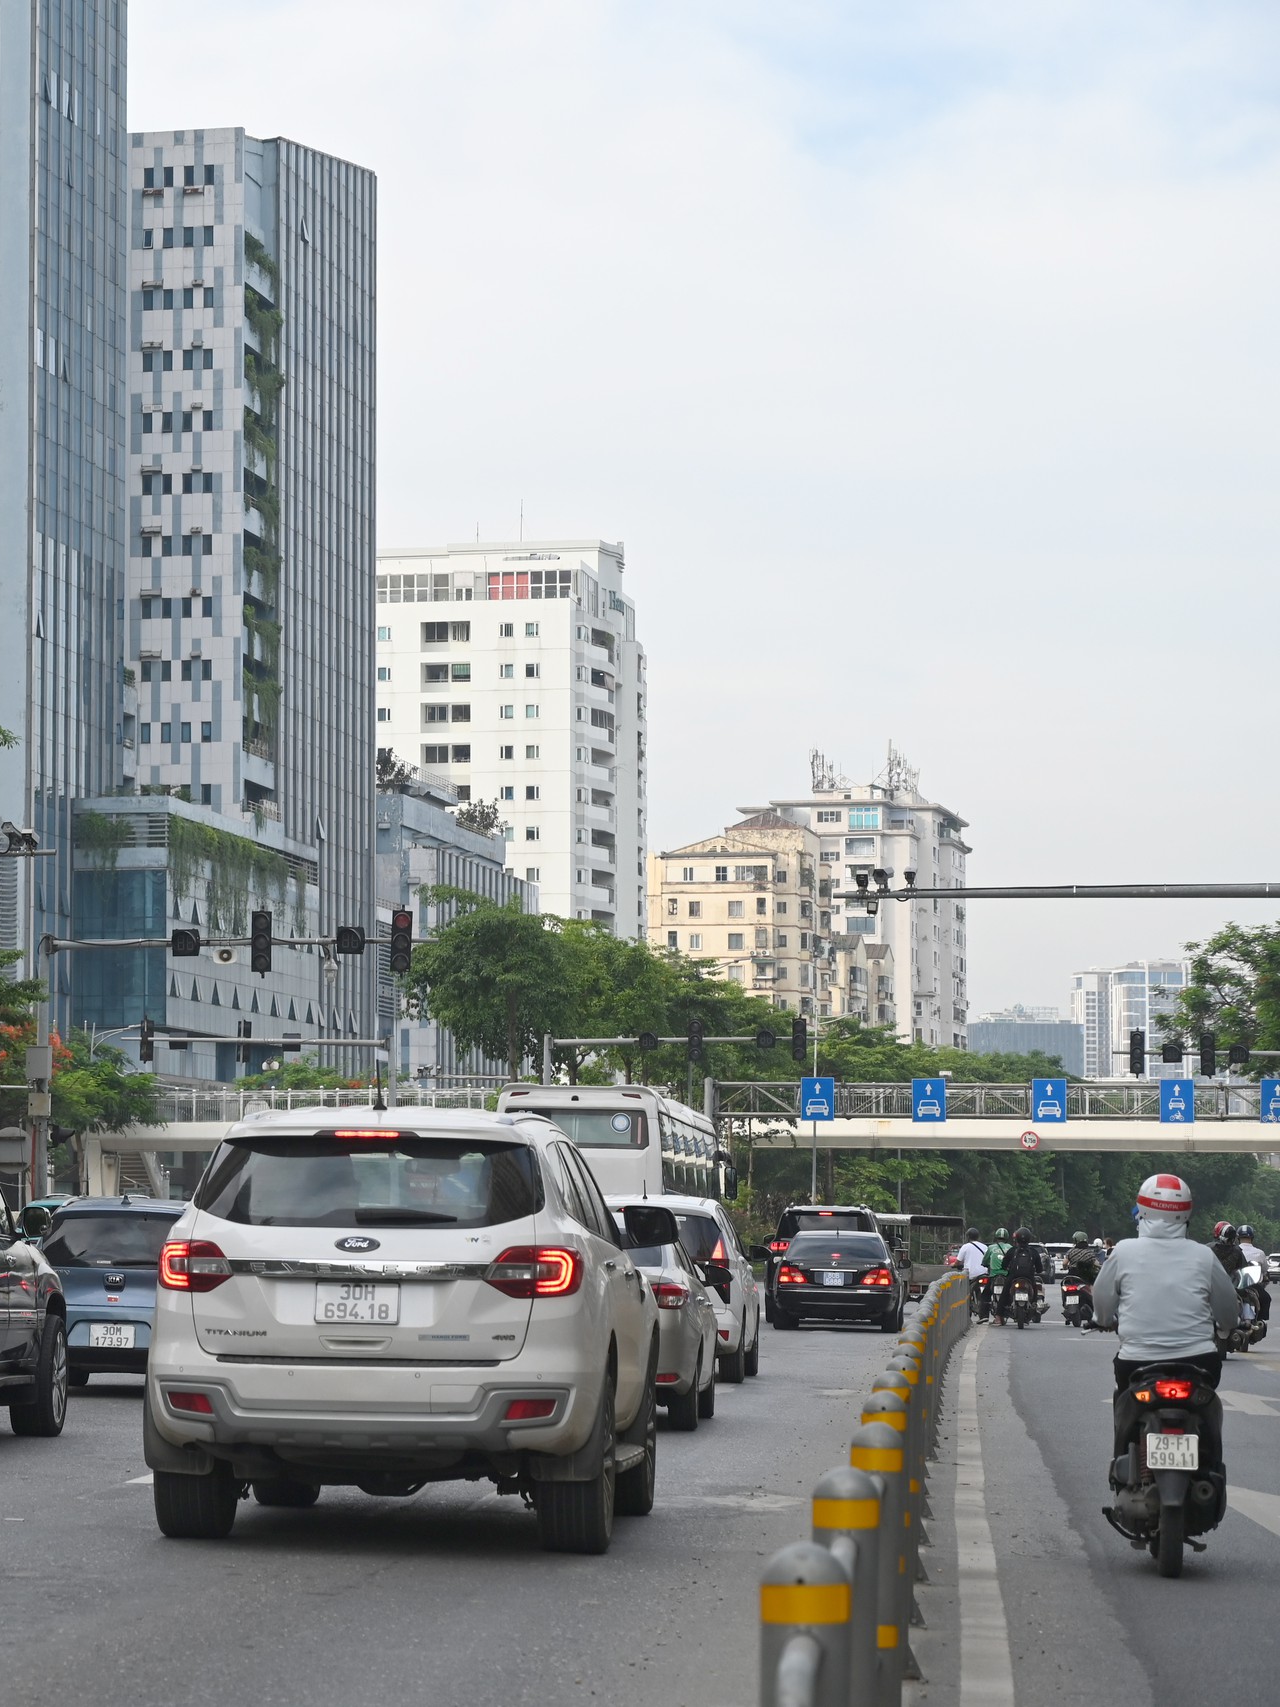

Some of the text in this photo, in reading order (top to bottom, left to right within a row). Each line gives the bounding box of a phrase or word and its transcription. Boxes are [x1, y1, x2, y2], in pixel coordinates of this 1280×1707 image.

[250, 1262, 465, 1276] EVEREST
[340, 1284, 375, 1300] 30H
[324, 1303, 389, 1319] 694.18
[103, 1326, 122, 1335] 30M
[96, 1337, 129, 1346] 173.97
[1156, 1437, 1189, 1451] 29-F1
[1151, 1452, 1194, 1467] 599.11
